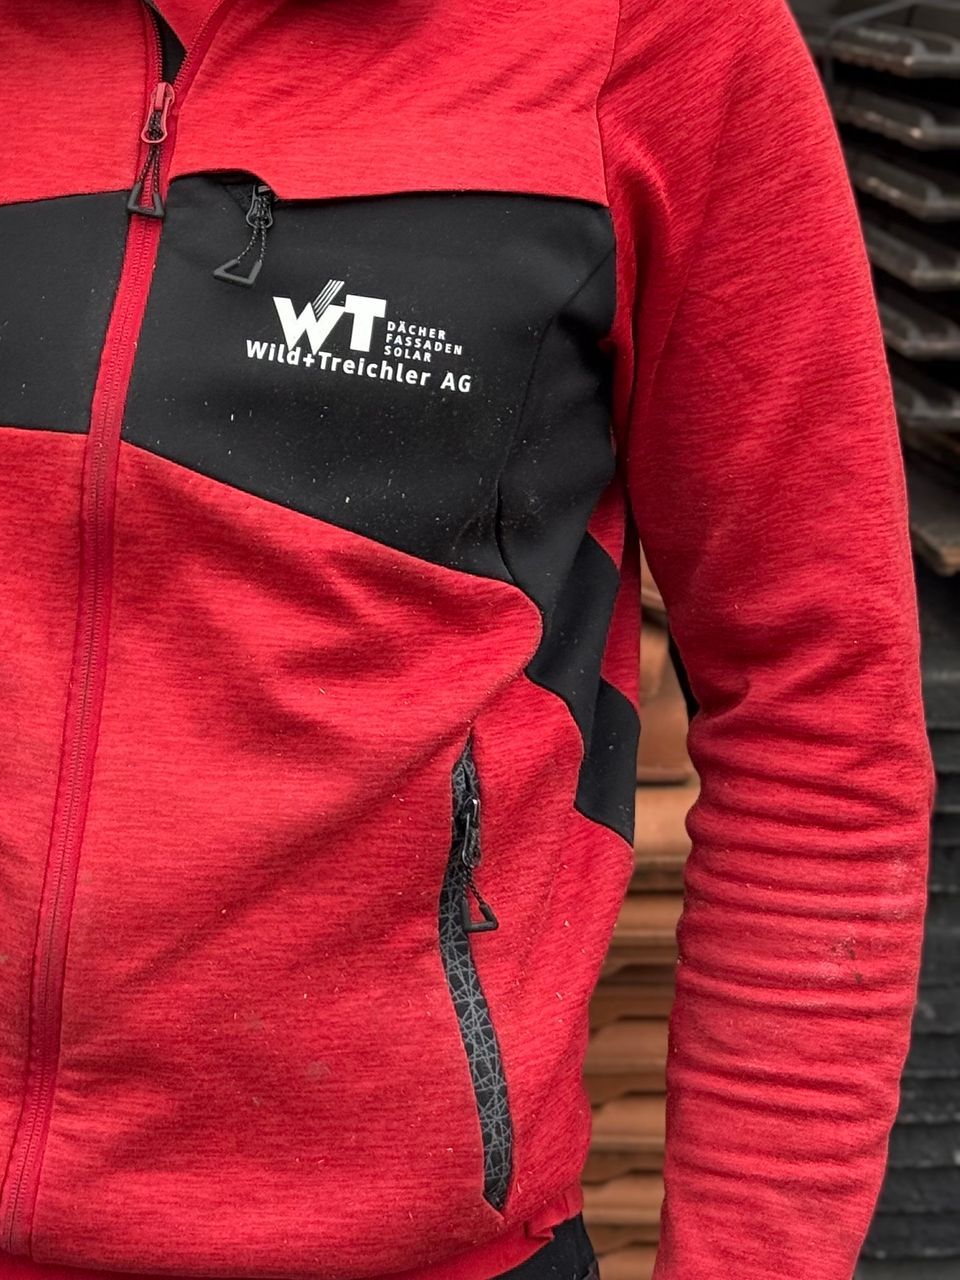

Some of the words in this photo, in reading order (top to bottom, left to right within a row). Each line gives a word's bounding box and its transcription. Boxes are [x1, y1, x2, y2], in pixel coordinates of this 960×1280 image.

[387, 320, 446, 340] DÄCHER
[384, 345, 432, 363] SOLAR
[385, 333, 463, 356] FASSADEN
[246, 339, 432, 386] Wild+Treichler
[440, 372, 472, 393] AG
